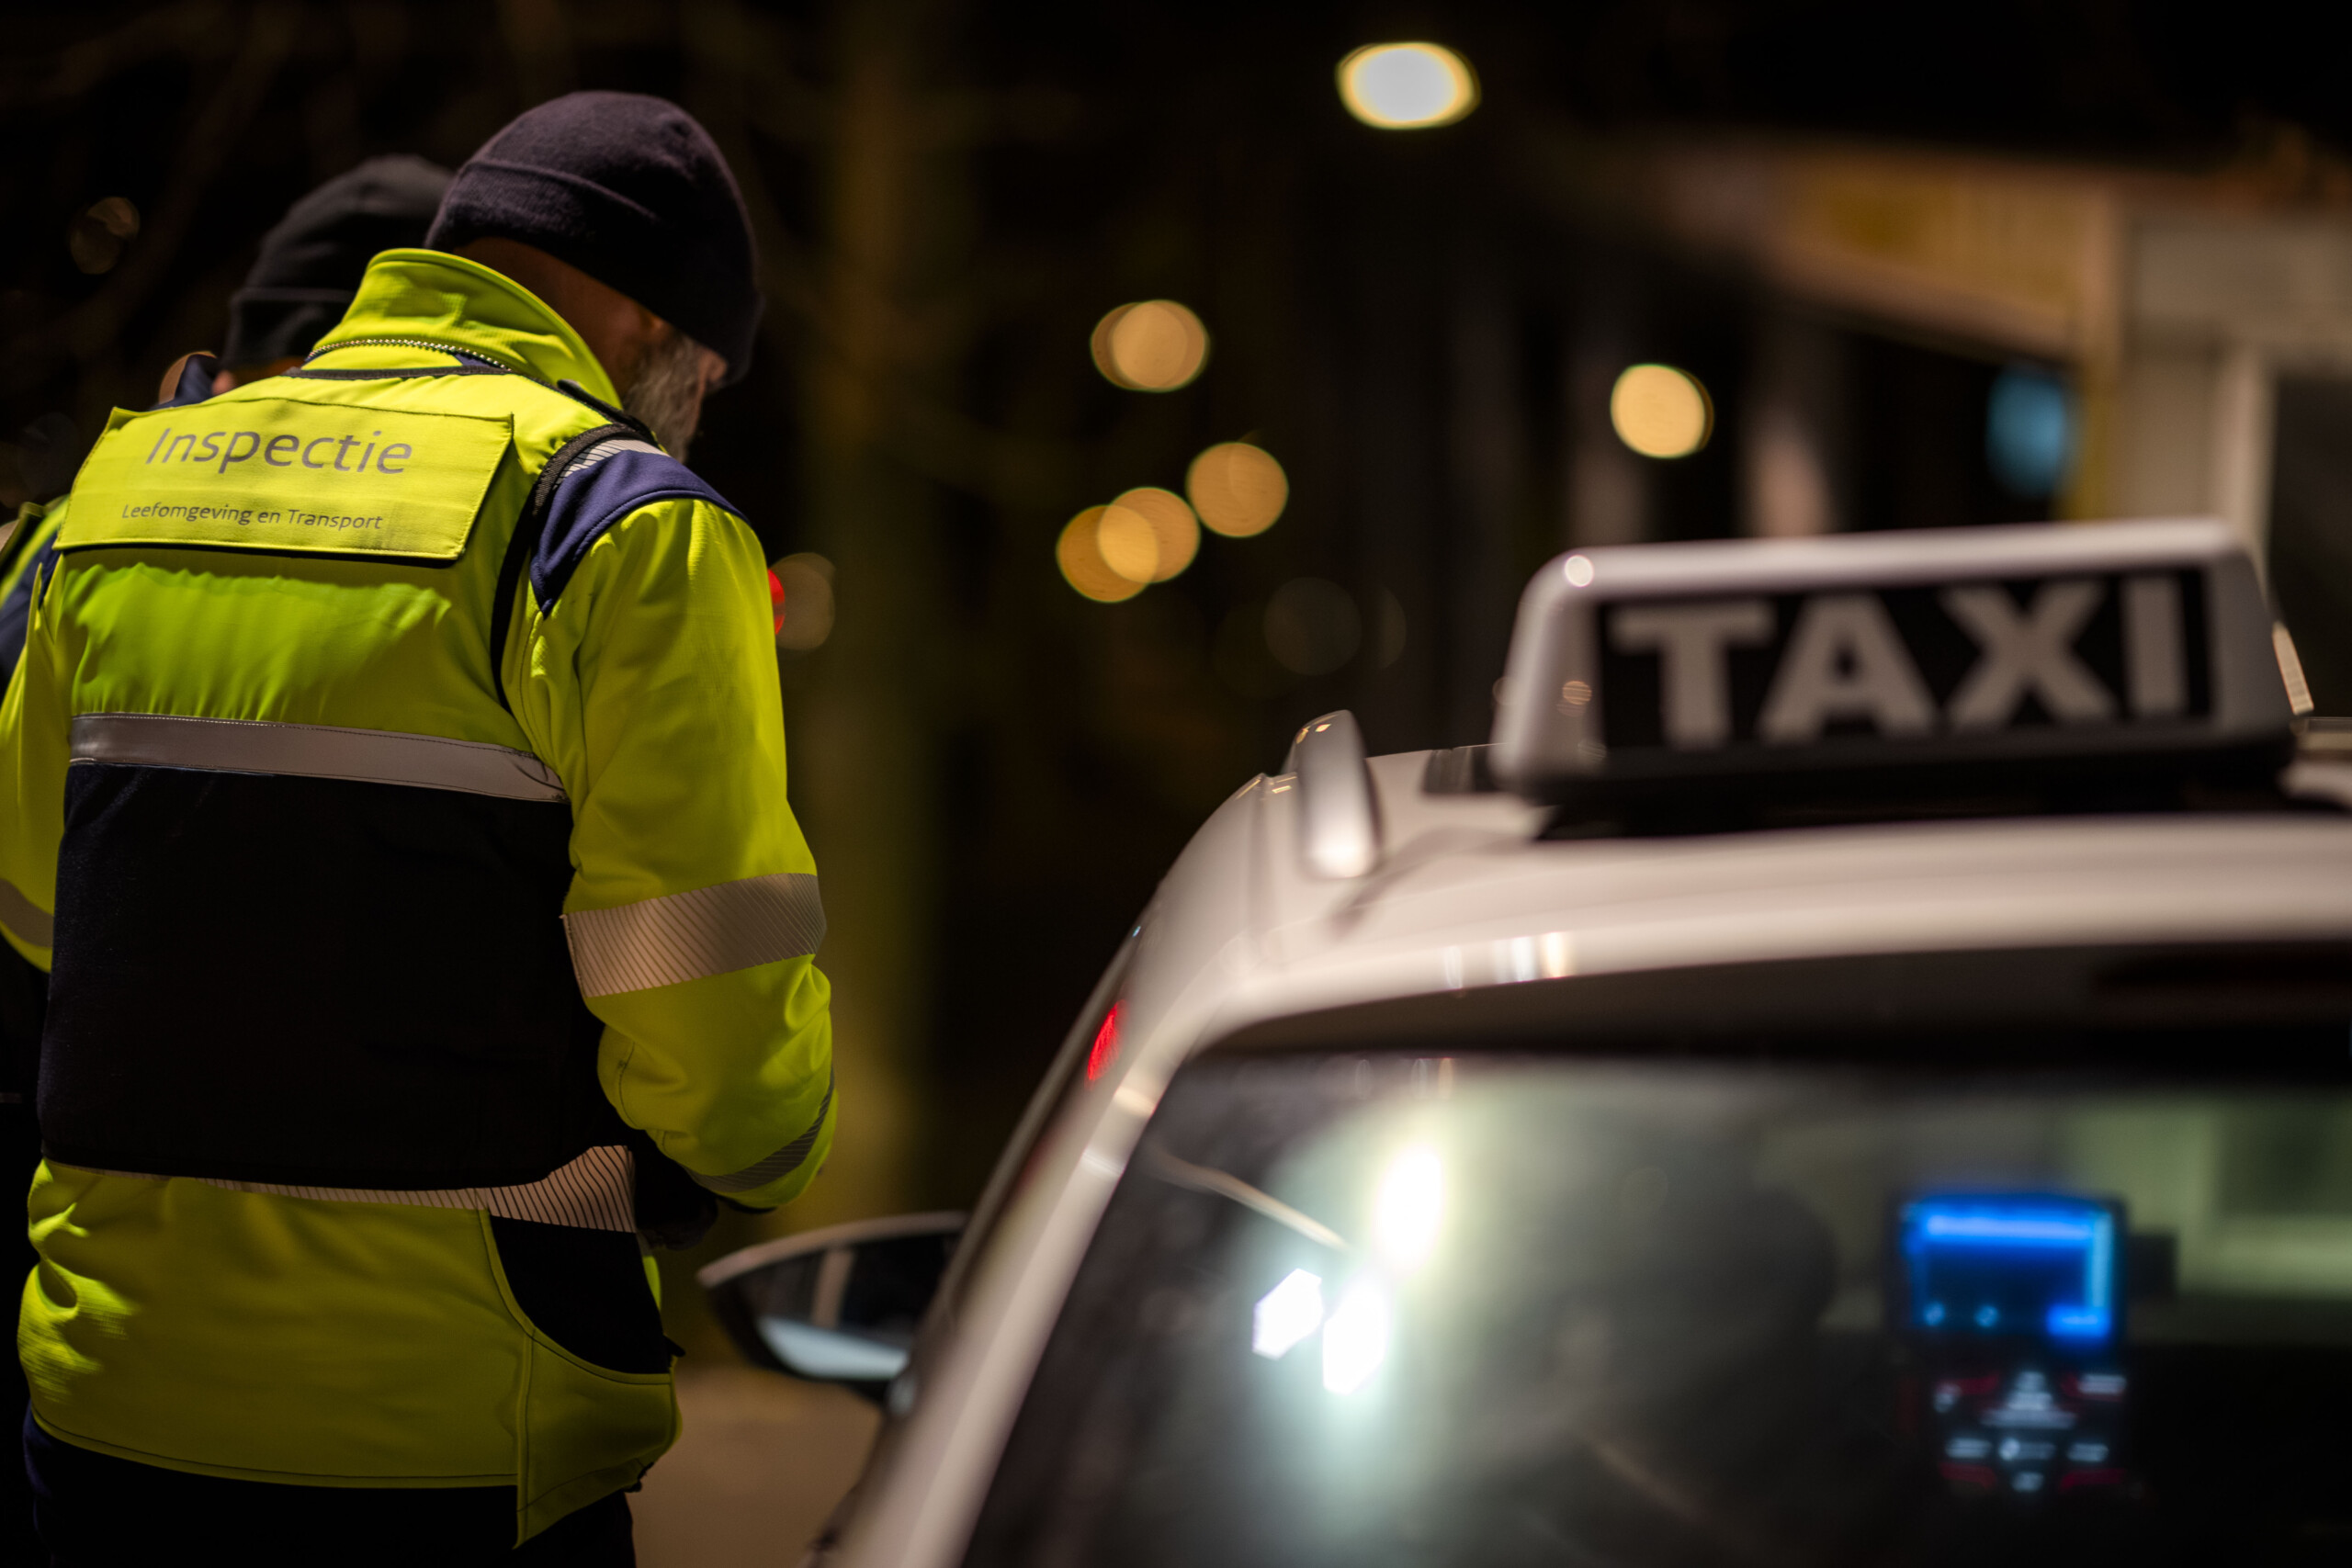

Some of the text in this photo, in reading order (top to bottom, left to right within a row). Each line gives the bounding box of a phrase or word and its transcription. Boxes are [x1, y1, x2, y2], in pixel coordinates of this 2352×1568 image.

[145, 427, 413, 475] Inspectie
[121, 502, 384, 531] Leefomgeving en Transport
[1610, 575, 2190, 750] TAXI
